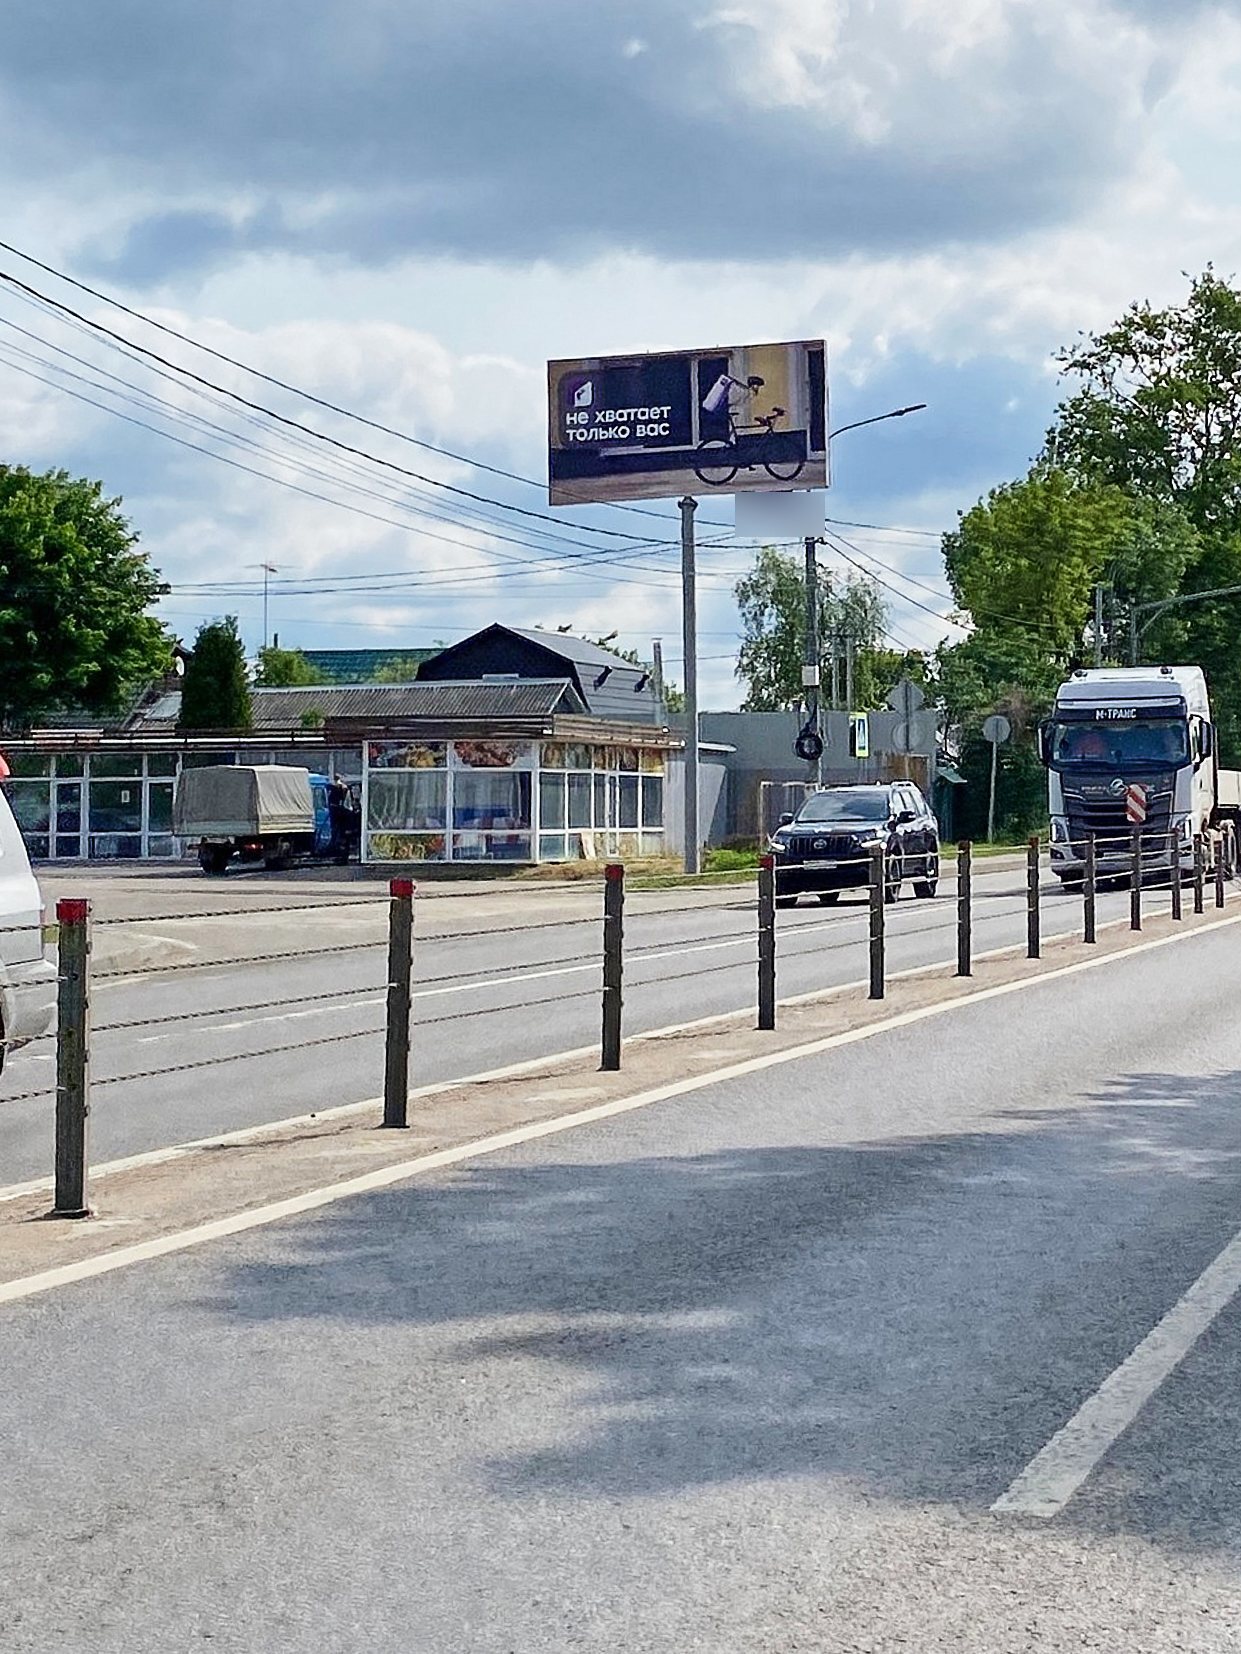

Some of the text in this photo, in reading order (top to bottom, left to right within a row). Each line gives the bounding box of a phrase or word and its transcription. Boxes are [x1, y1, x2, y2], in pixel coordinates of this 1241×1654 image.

[566, 406, 671, 425] не хватает
[566, 422, 670, 441] только вас
